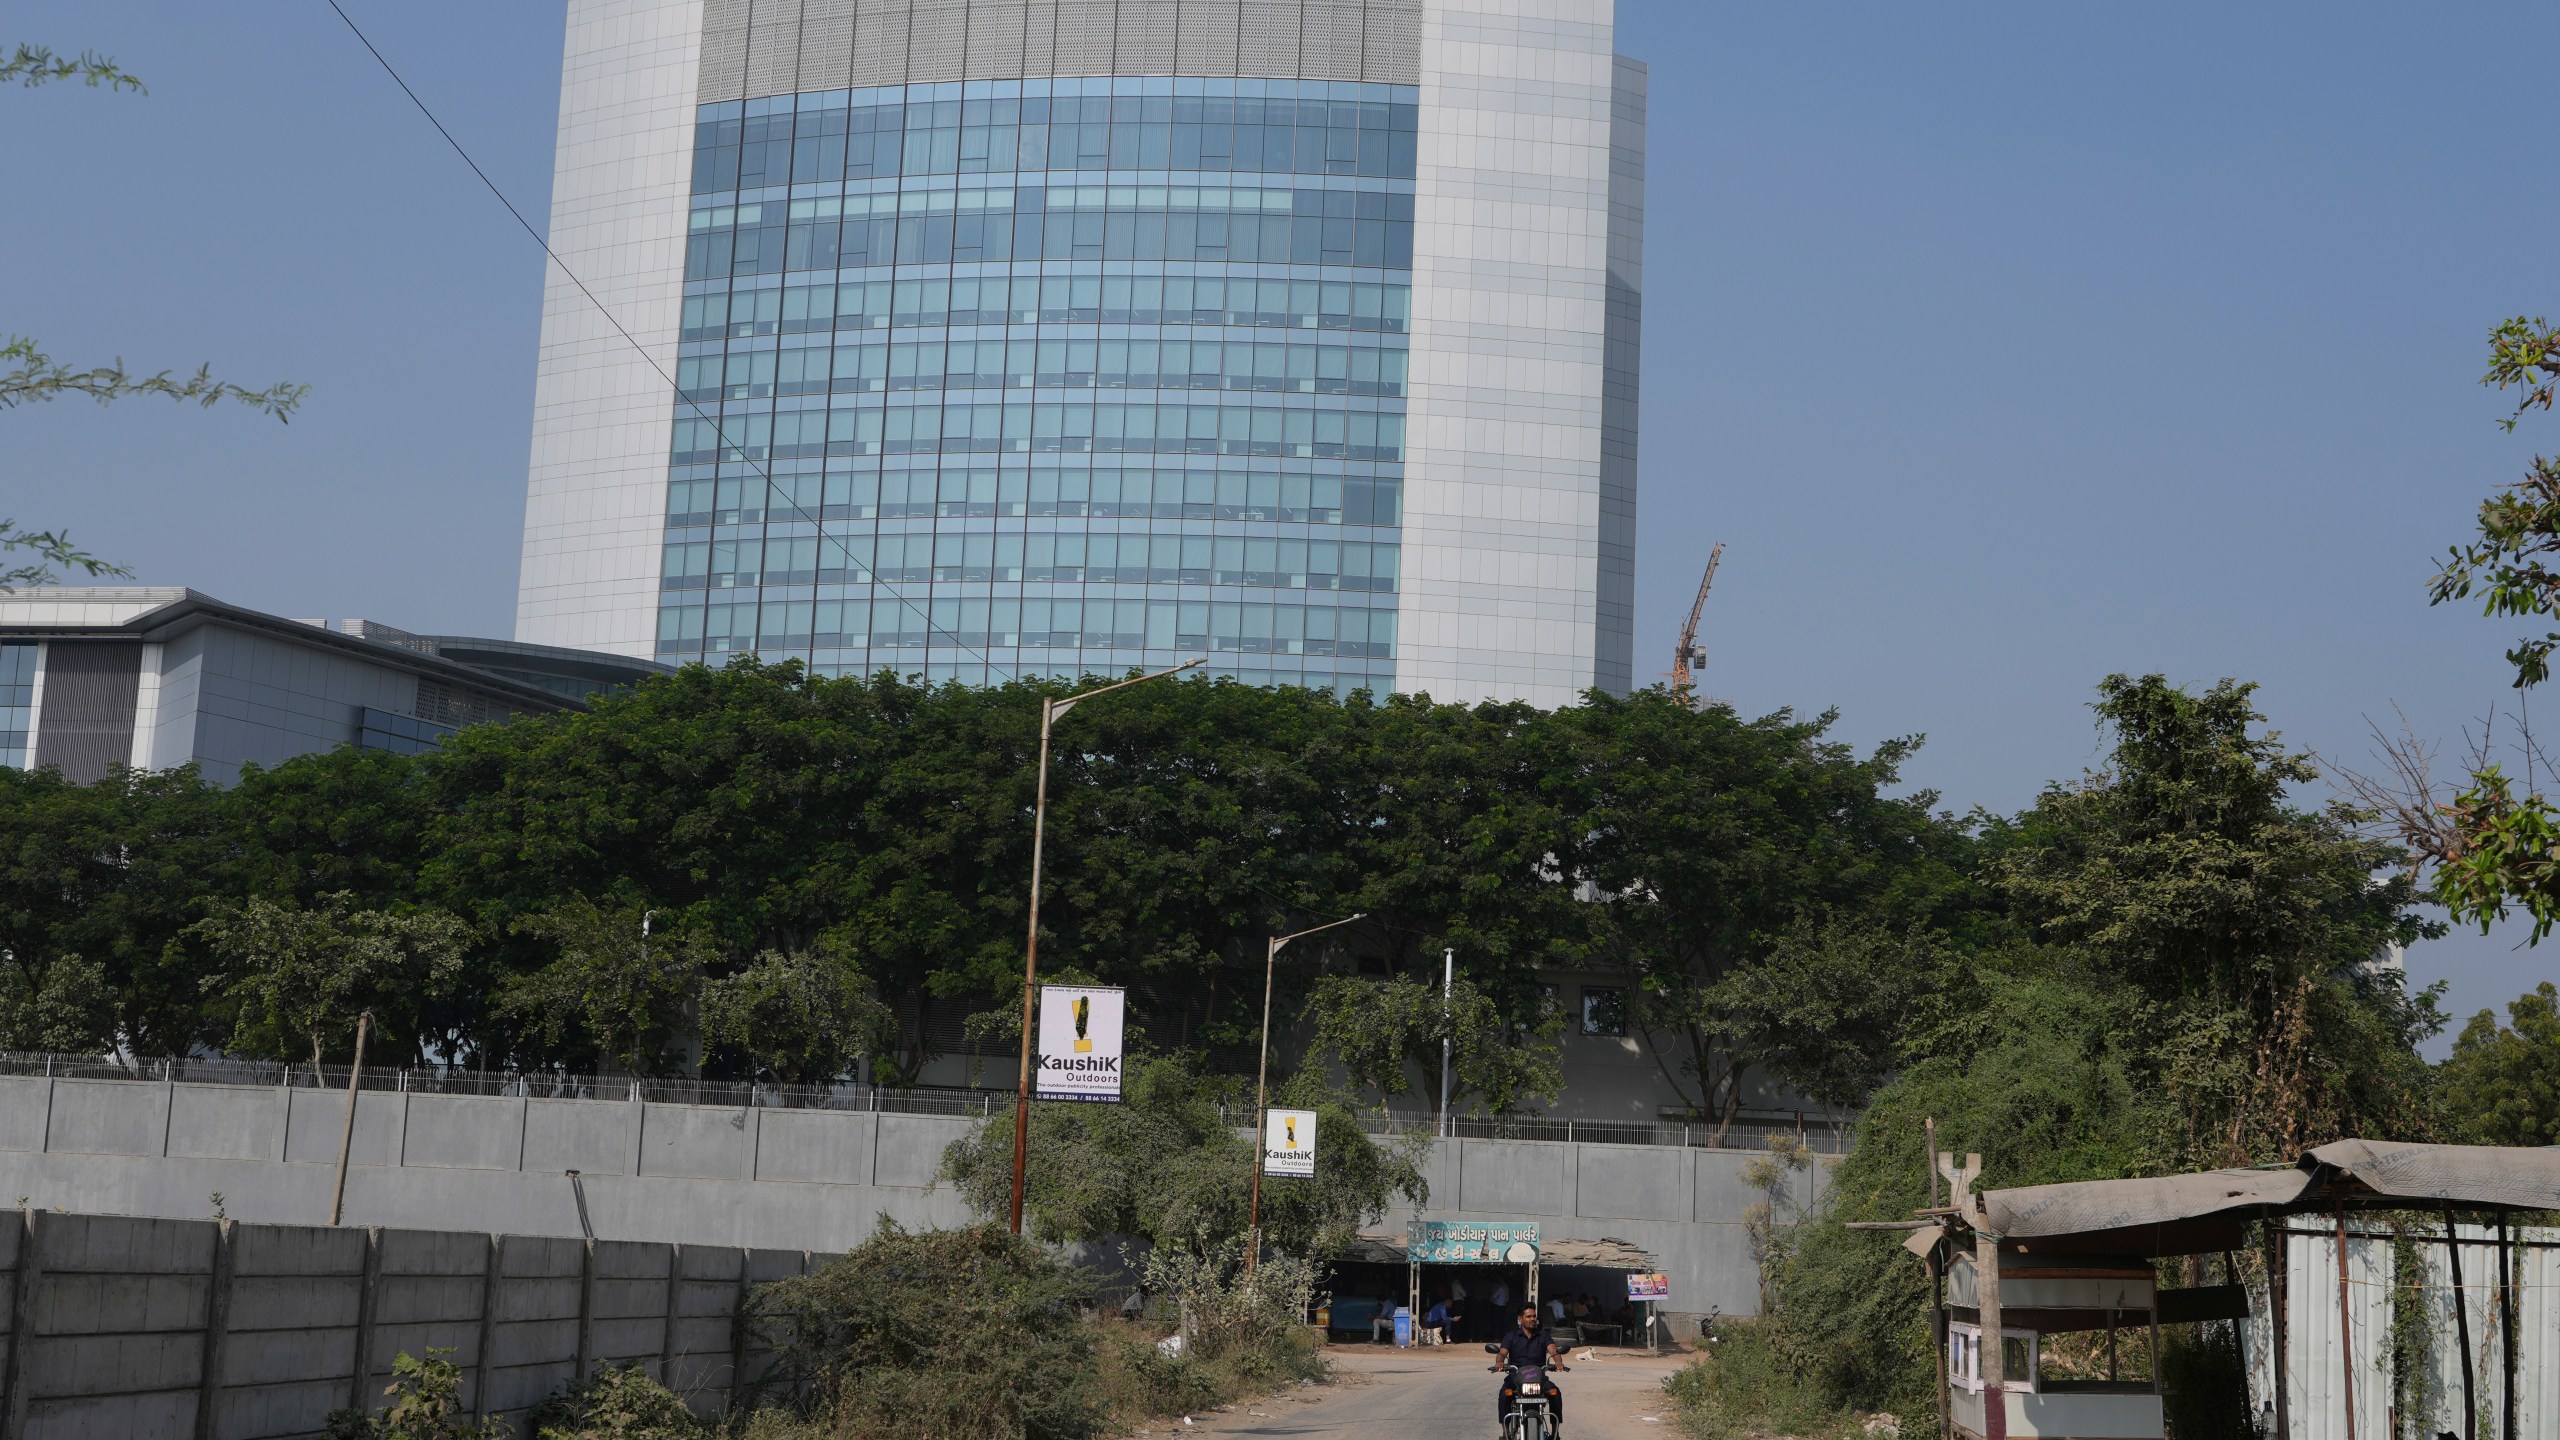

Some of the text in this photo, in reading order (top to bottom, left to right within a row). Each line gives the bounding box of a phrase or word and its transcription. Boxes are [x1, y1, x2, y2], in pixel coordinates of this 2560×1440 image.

[1038, 1054, 1118, 1072] KaushiK
[1066, 1073, 1118, 1083] Outdoors
[1265, 1150, 1312, 1160] KaushiK
[1428, 1229, 1444, 1241] જય
[1490, 1229, 1510, 1242] પાન
[1513, 1224, 1538, 1242] પાર્લર
